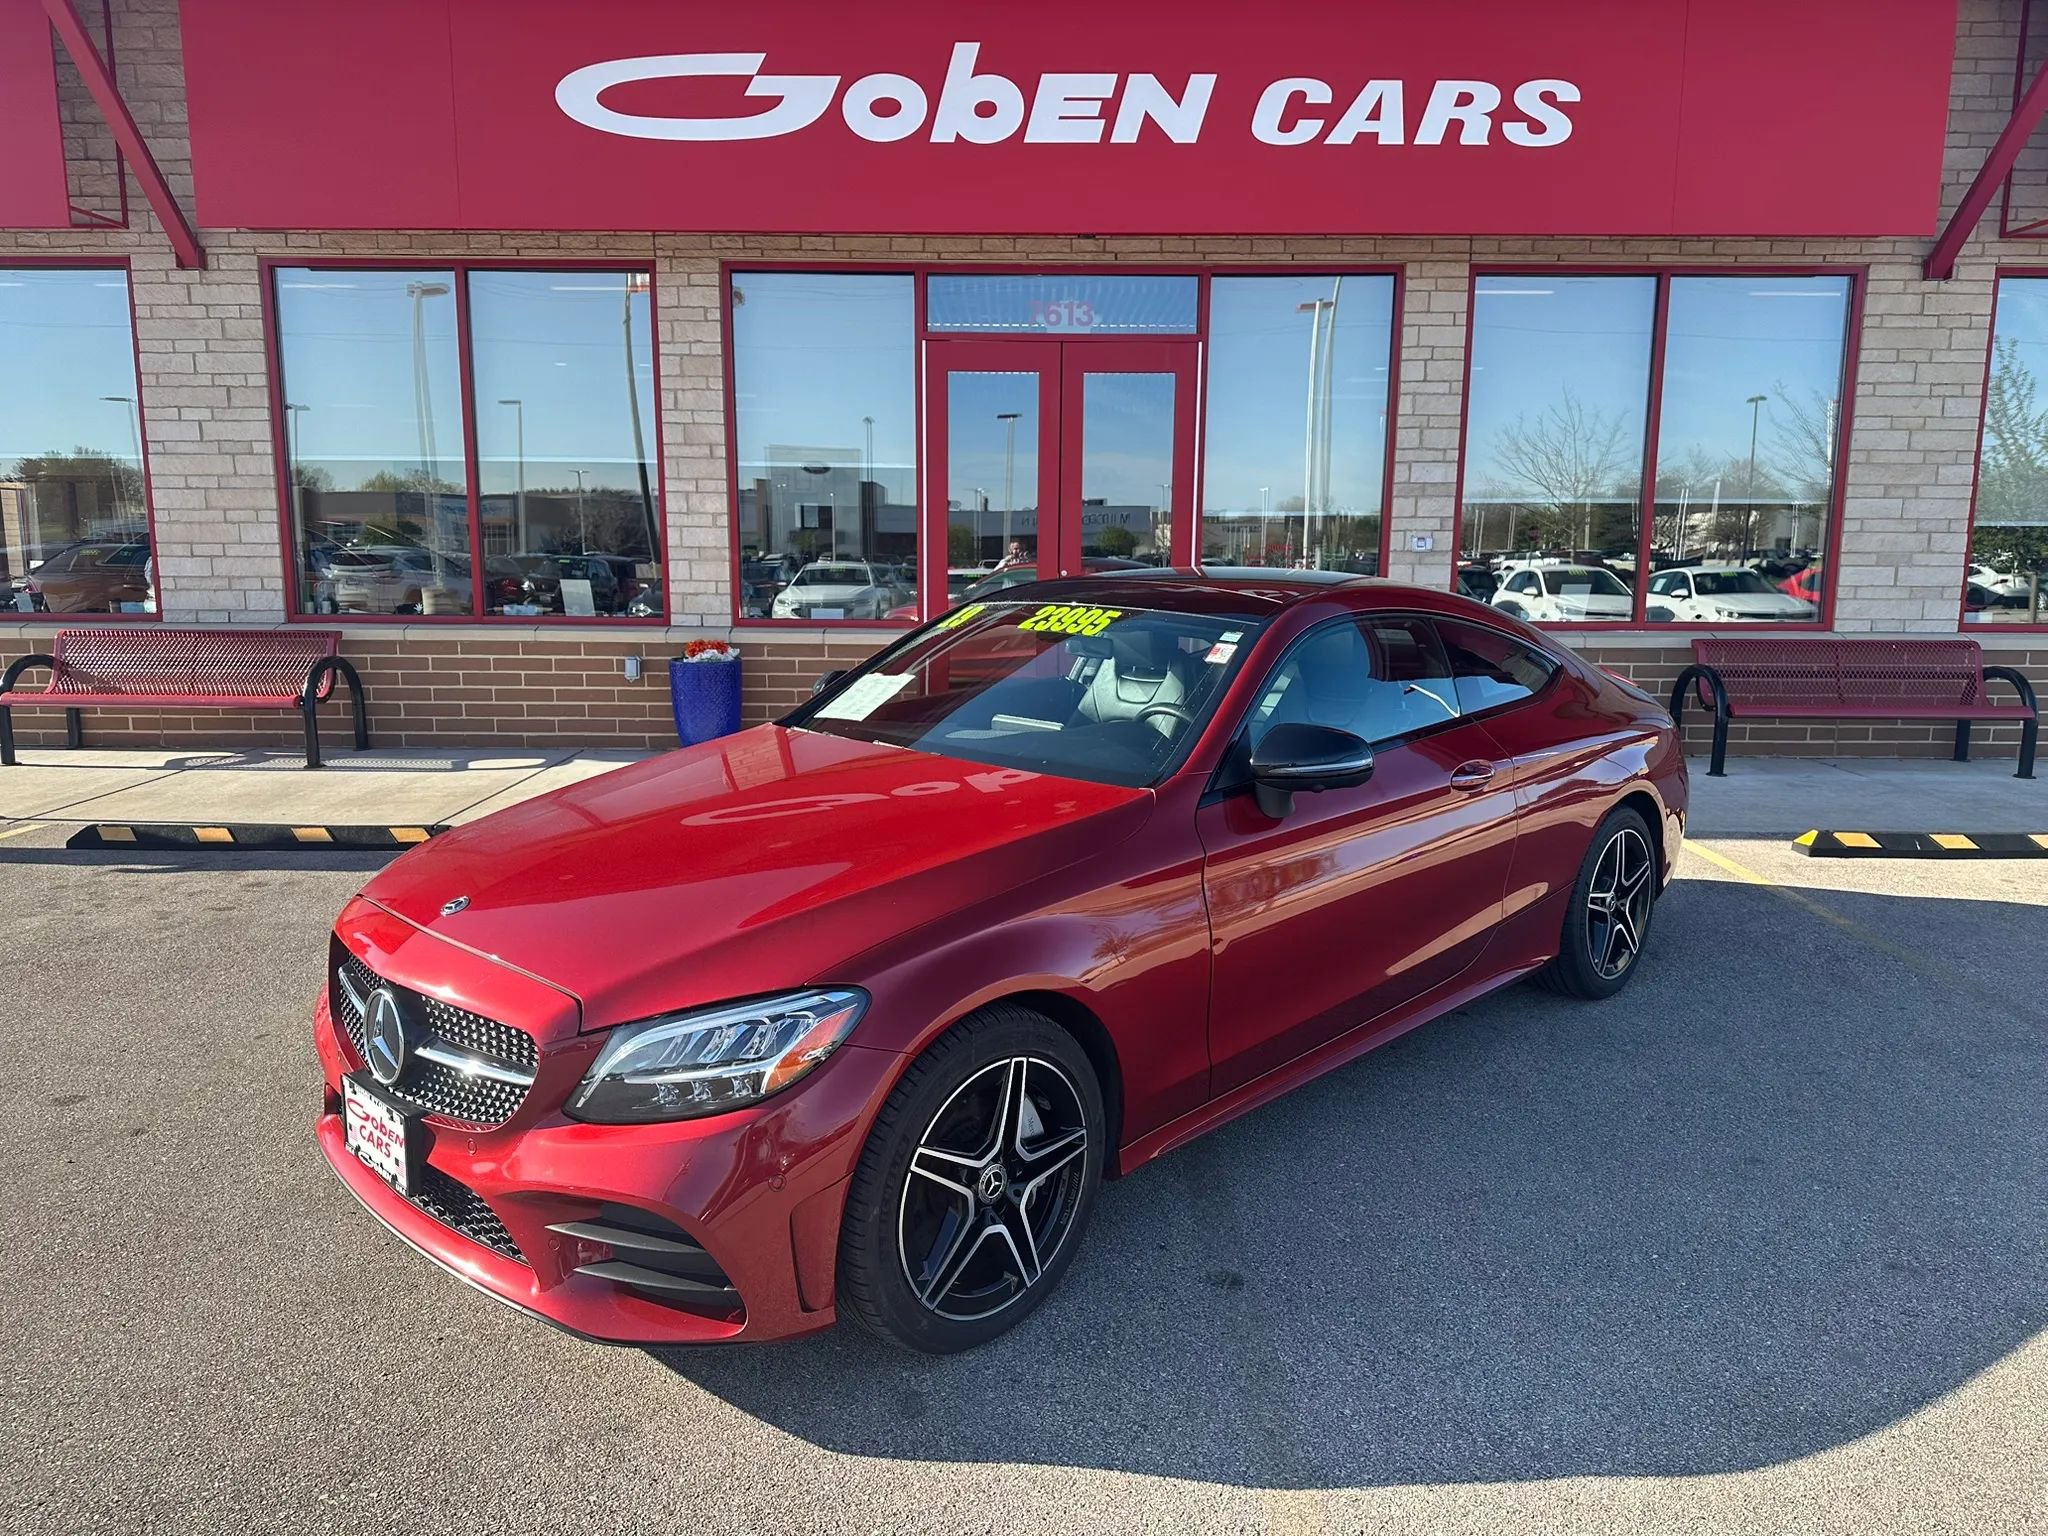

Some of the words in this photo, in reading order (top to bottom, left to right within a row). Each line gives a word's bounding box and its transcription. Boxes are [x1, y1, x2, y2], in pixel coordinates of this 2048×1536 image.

[1251, 77, 1582, 147] CARS
[1027, 299, 1094, 327] 7613
[1017, 605, 1122, 636] 23995
[359, 1124, 391, 1159] CARS
